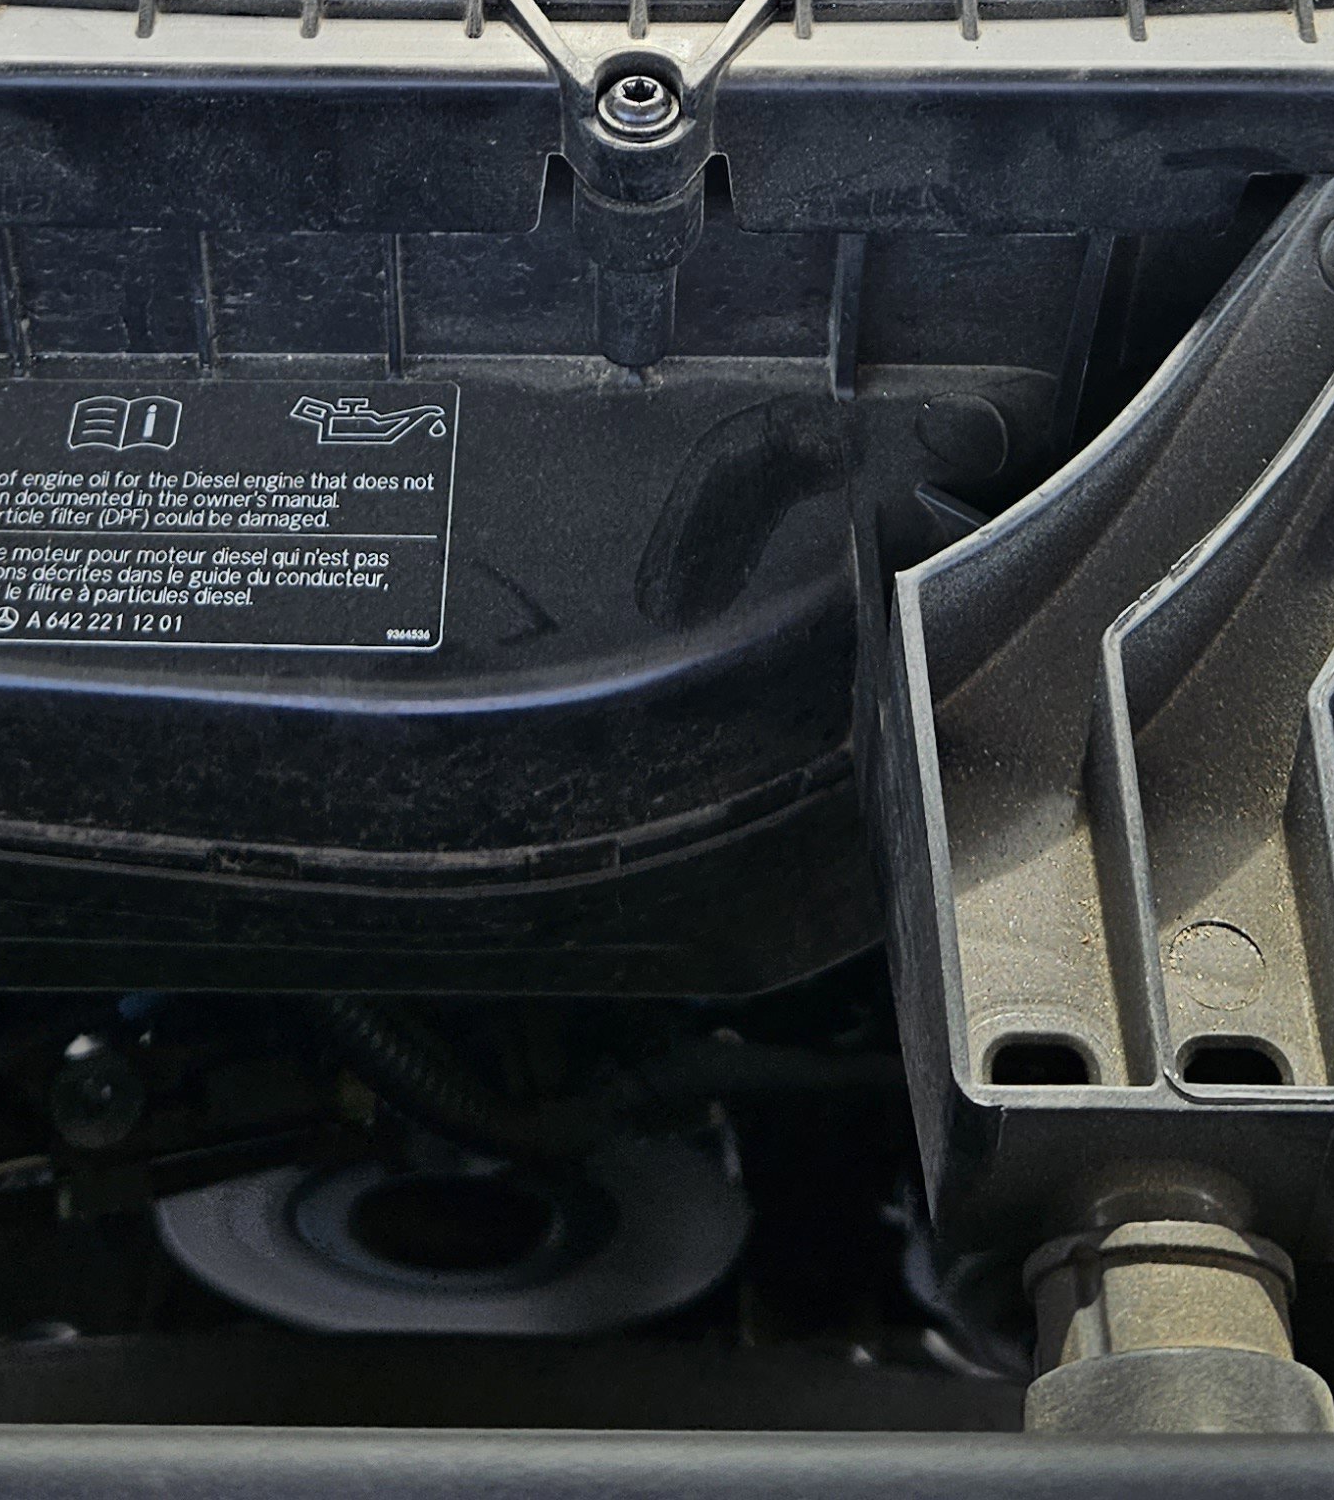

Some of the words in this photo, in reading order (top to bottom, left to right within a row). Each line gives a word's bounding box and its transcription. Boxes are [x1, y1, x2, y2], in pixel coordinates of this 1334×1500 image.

[22, 470, 84, 490] engine
[89, 471, 111, 487] oil
[114, 471, 142, 487] for
[148, 471, 178, 488] the
[183, 470, 239, 488] Diesel
[243, 472, 305, 492] engine
[310, 472, 348, 489] that
[353, 473, 399, 490] does
[403, 473, 434, 490] not
[15, 488, 134, 506] documented
[137, 490, 152, 506] in
[158, 490, 188, 507] the
[193, 491, 267, 508] owner's
[271, 492, 340, 508] manual.
[49, 508, 94, 524] filter
[99, 508, 149, 529] (DPF)
[154, 510, 204, 526] could
[208, 510, 232, 526] be
[238, 511, 330, 531] damaged.
[11, 545, 82, 562] moteur
[87, 548, 131, 565] pour
[136, 549, 206, 565] moteur
[211, 546, 267, 565] diesel
[271, 547, 300, 569] qui
[304, 549, 350, 566] n'est
[354, 550, 390, 570] pas
[32, 563, 112, 582] décrites
[117, 565, 163, 584] dans
[168, 565, 183, 584] le
[188, 567, 242, 588] guide
[247, 567, 271, 585] du
[275, 569, 390, 590] conducteur,
[4, 582, 22, 599] le
[27, 583, 73, 601] filtre
[78, 584, 90, 601] à
[93, 584, 189, 606] particules
[194, 587, 254, 605] diesel.
[25, 611, 41, 629] A
[45, 612, 83, 630] 642
[86, 613, 124, 631] 221
[133, 613, 154, 632] 12
[158, 614, 183, 633] 01
